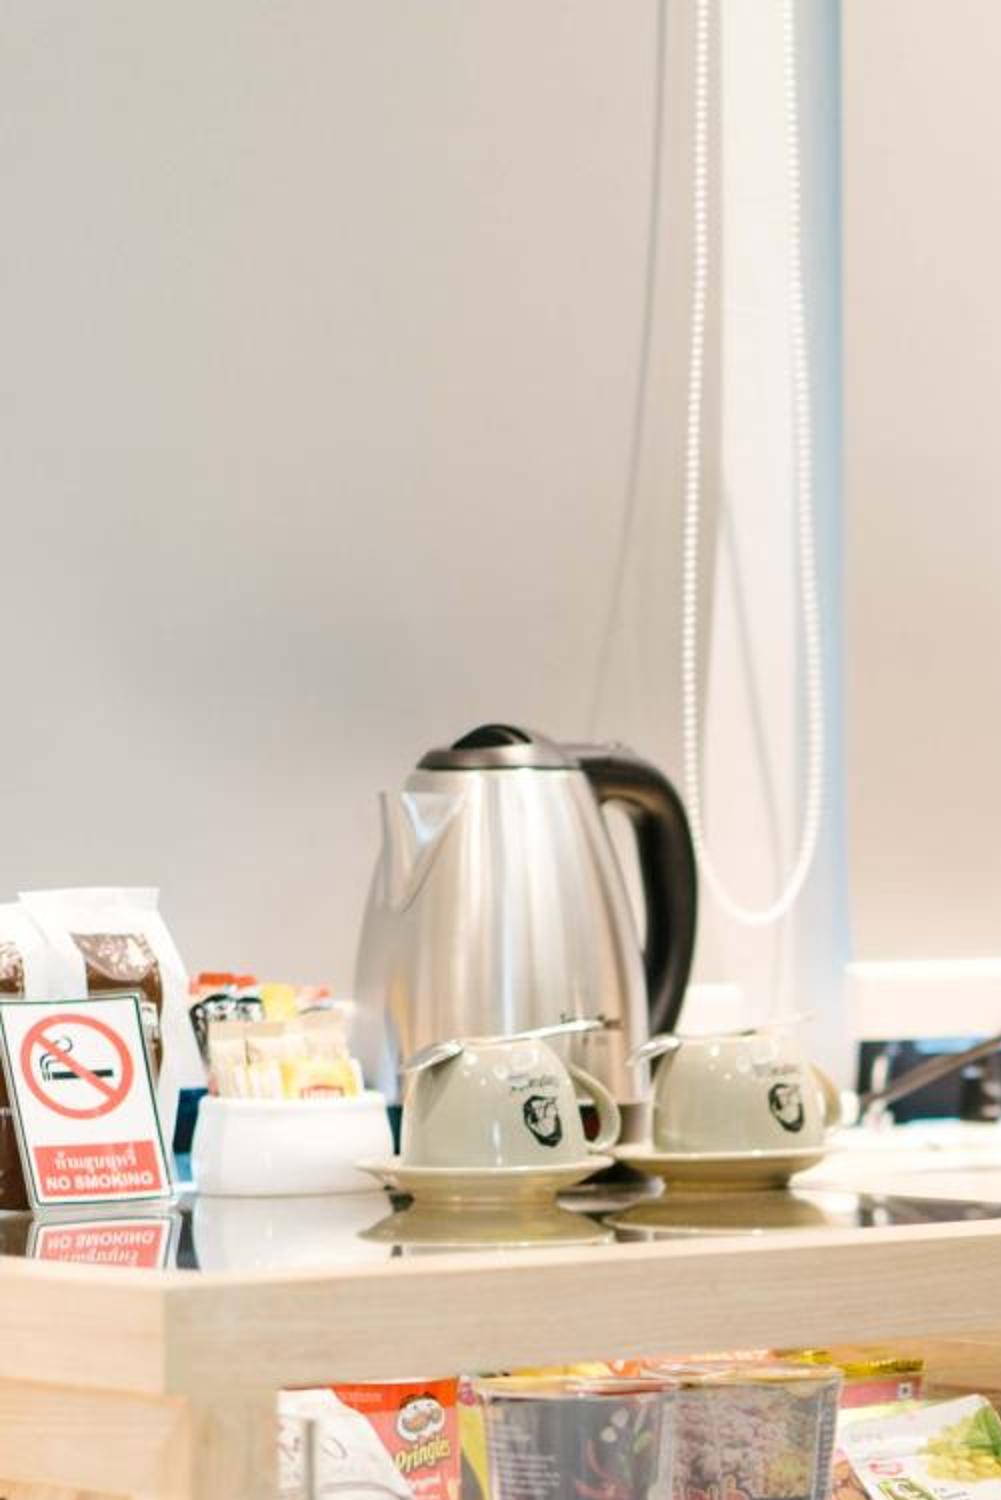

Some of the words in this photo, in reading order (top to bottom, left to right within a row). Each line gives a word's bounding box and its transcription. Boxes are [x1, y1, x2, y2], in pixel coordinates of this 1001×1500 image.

[46, 1174, 71, 1191] NO
[74, 1170, 154, 1190] SMOKING
[395, 1435, 451, 1473] Pringles
